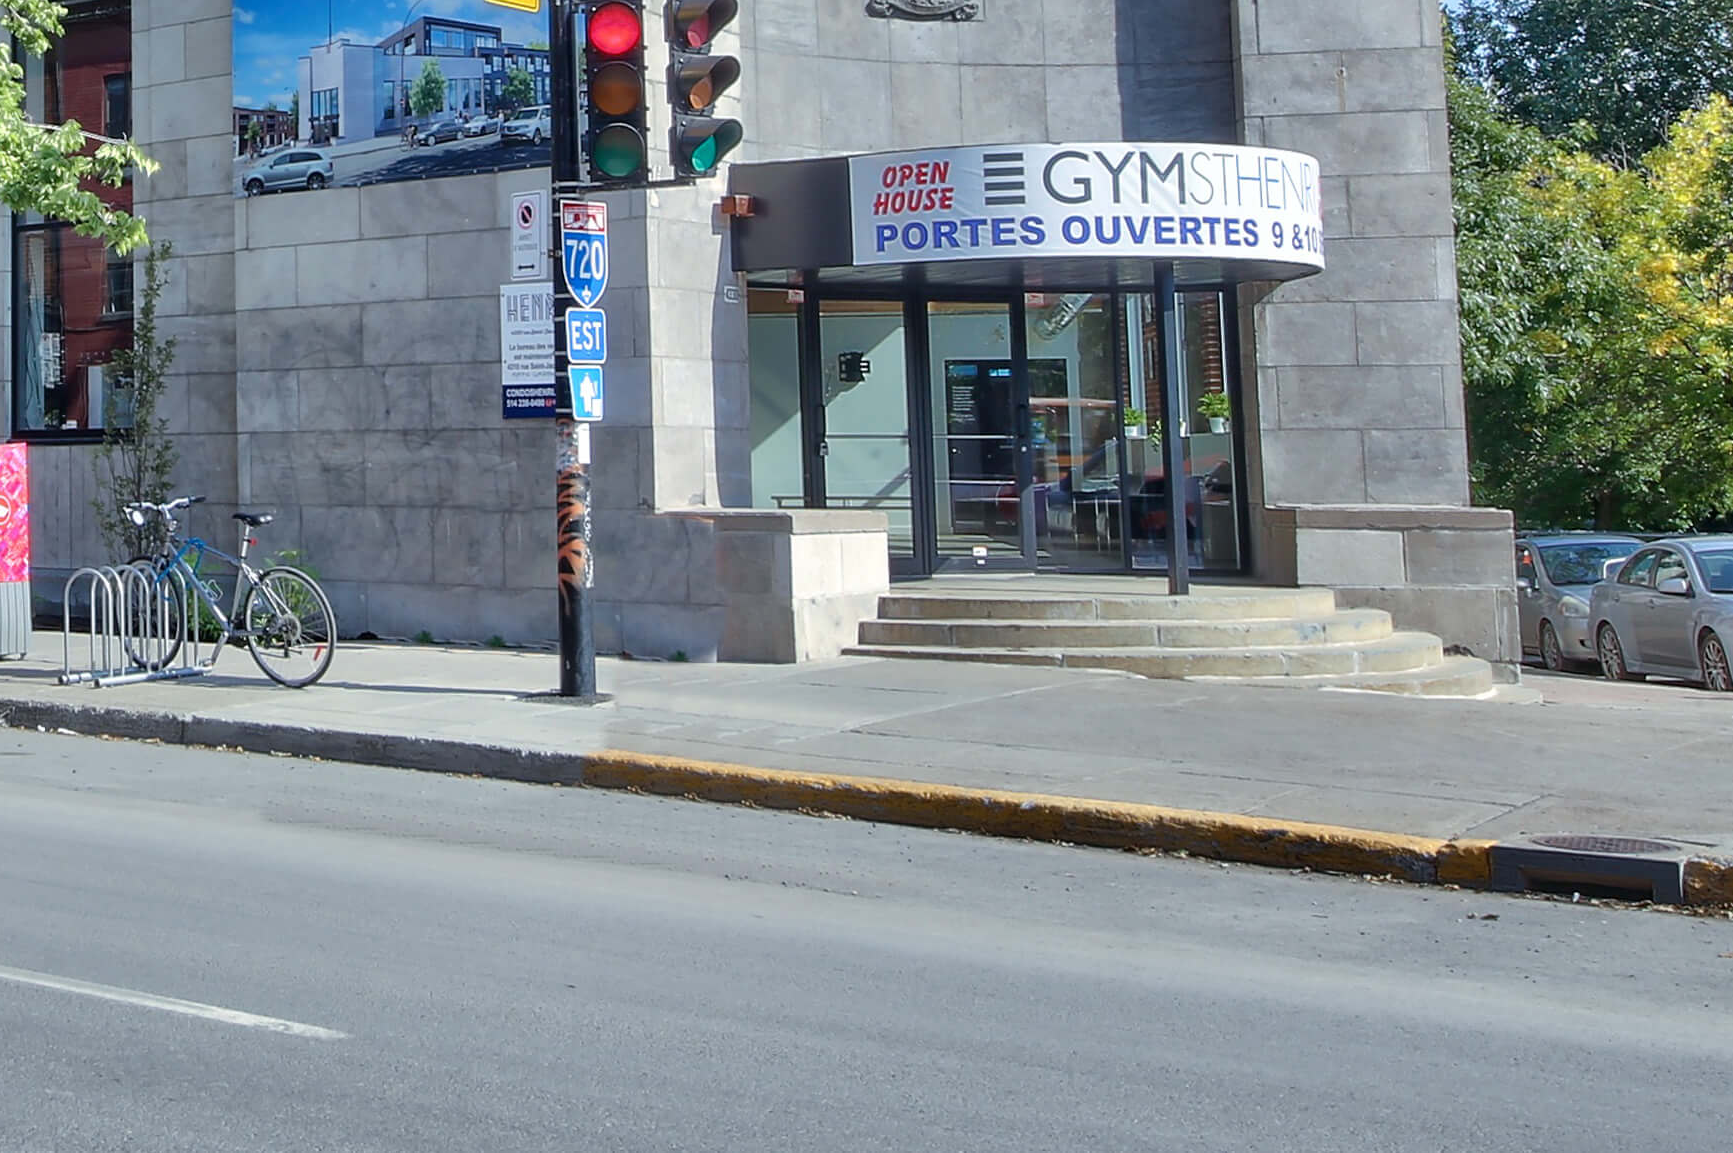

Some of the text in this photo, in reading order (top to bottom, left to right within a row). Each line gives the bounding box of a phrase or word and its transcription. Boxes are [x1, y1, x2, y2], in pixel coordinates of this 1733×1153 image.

[882, 161, 951, 189] OPEN
[872, 187, 955, 216] HOUSE
[875, 215, 1046, 253] PORTES
[1061, 215, 1260, 248] OUVERTES
[1271, 220, 1285, 249] 9
[565, 238, 605, 281] 720
[570, 320, 603, 351] EST
